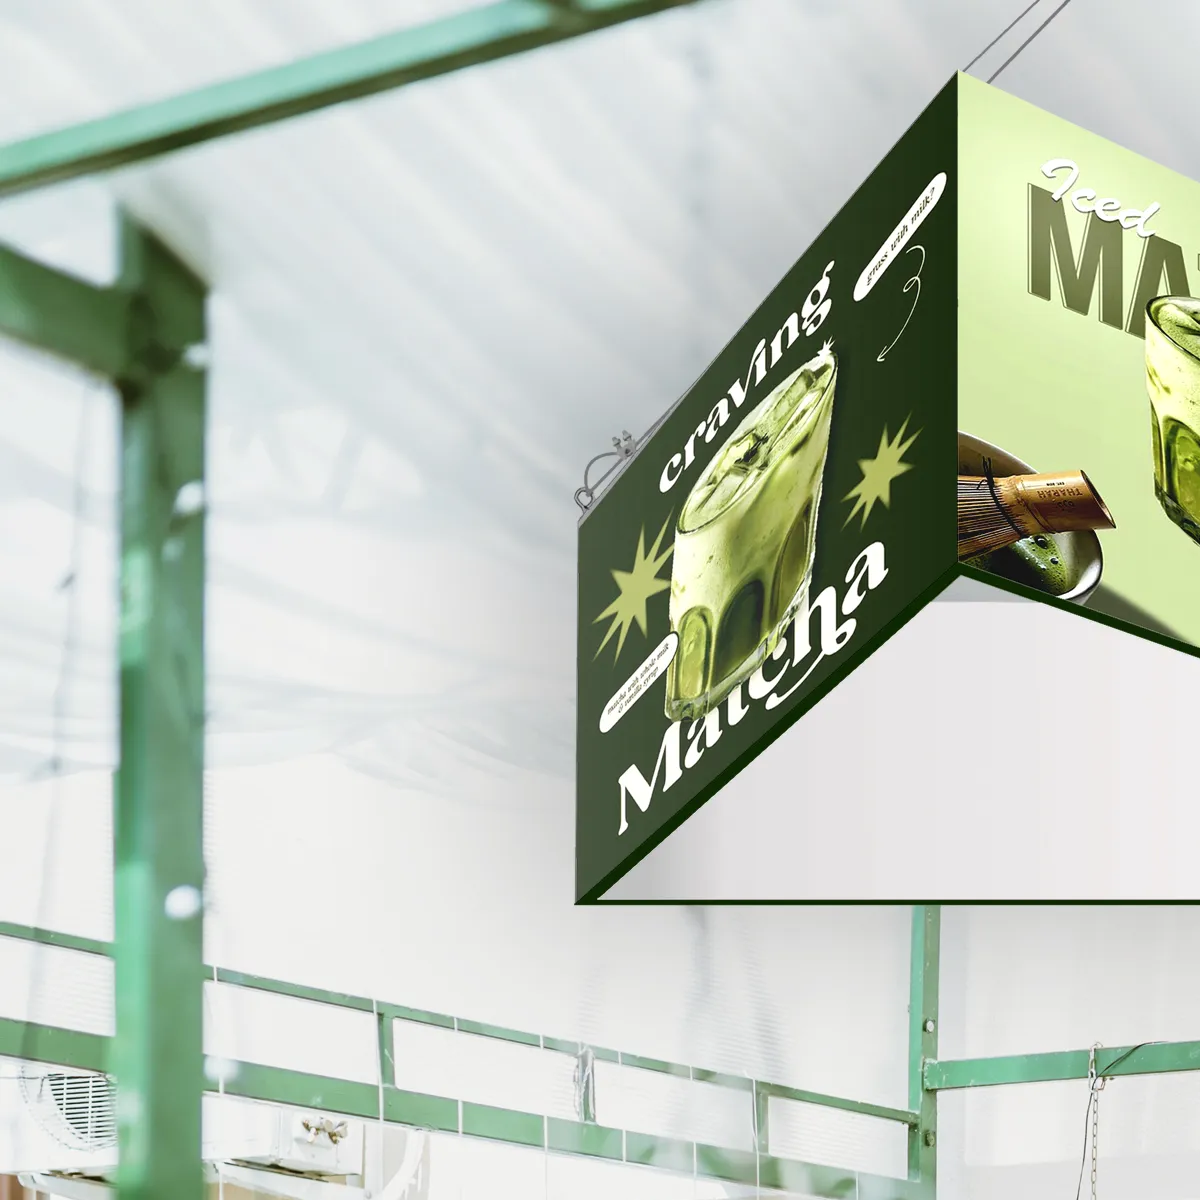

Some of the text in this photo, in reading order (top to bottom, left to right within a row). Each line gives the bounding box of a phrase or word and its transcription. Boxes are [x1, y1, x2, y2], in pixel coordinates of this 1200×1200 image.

[891, 224, 909, 252] with
[1040, 158, 1161, 239] Iced
[659, 260, 835, 493] craving
